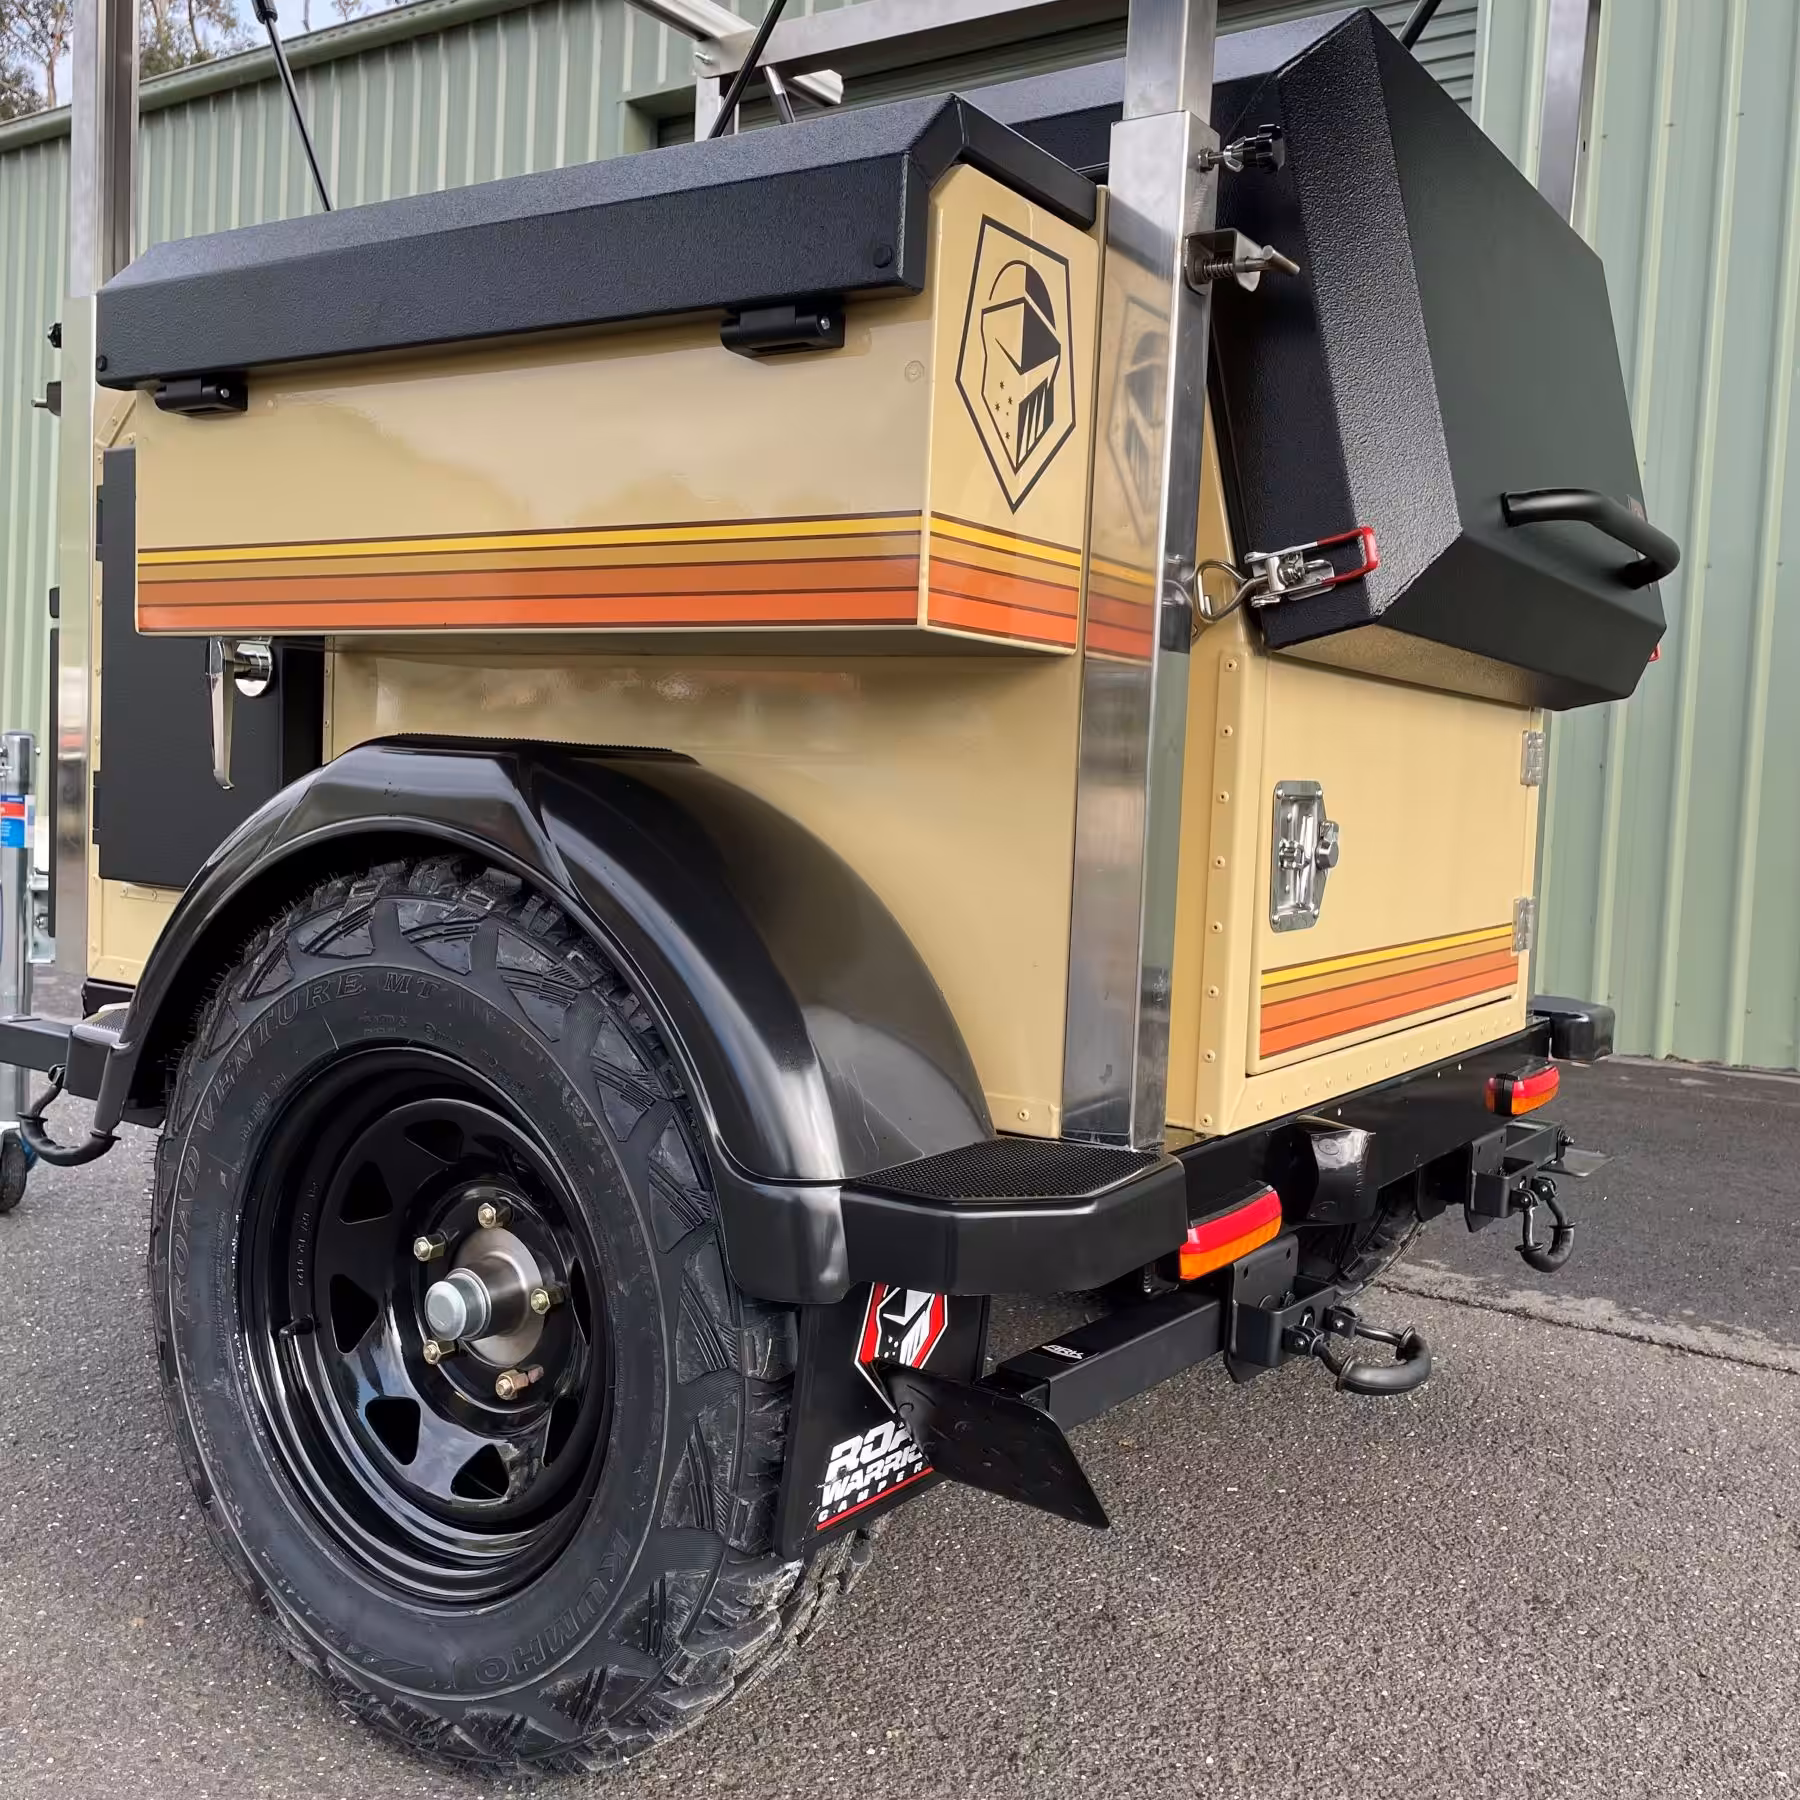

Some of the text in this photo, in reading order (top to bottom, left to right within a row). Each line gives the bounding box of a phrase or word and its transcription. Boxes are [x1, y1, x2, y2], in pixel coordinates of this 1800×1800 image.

[197, 971, 367, 1134] VENTURE
[382, 970, 442, 1000] MT
[821, 1443, 923, 1508] WARRIO
[824, 1420, 913, 1484] ROA
[817, 1461, 923, 1523] CAMPER
[474, 1527, 632, 1686] KUMHO
